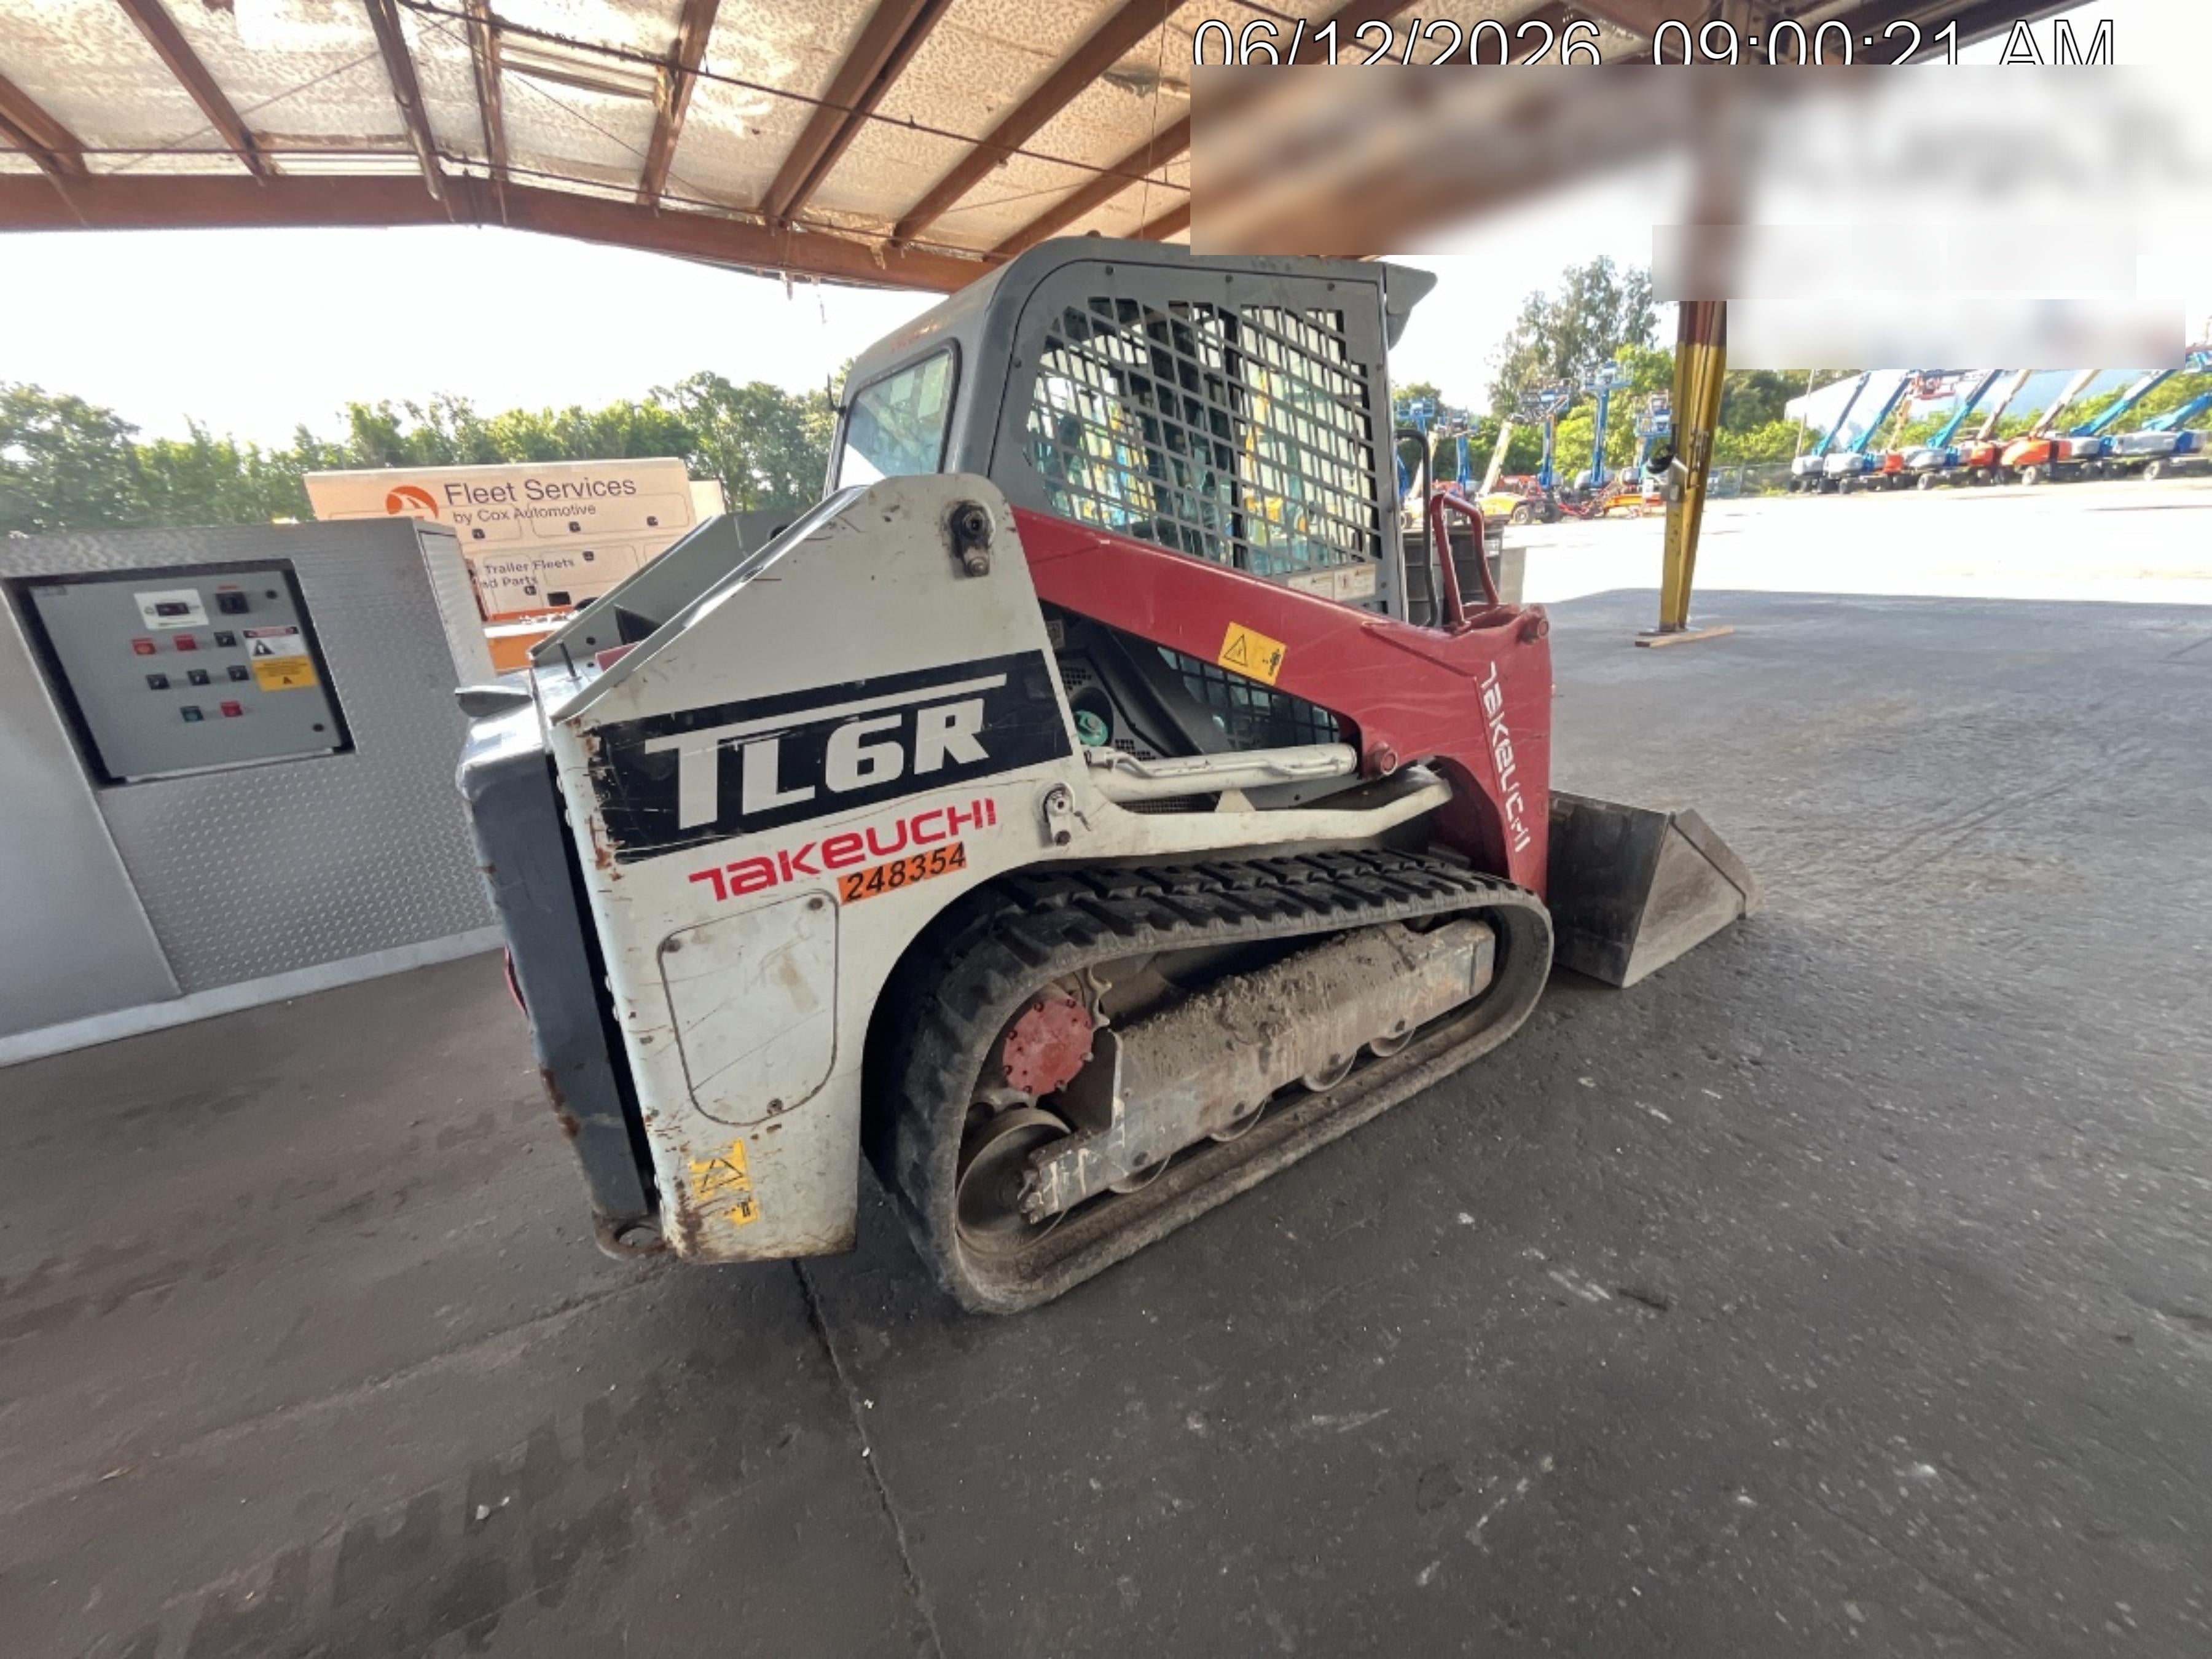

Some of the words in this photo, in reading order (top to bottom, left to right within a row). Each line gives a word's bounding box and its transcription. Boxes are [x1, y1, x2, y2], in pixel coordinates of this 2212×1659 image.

[444, 482, 517, 506] Fleet
[524, 477, 637, 500] Services
[453, 511, 472, 525] by
[477, 509, 509, 522] Cox
[514, 503, 596, 520] Automotive
[485, 562, 528, 574] Trailer
[532, 558, 575, 570] Fleets
[482, 578, 498, 588] nd
[502, 576, 538, 586] Parts
[645, 673, 1007, 831] TL6R
[844, 841, 967, 902] 248354
